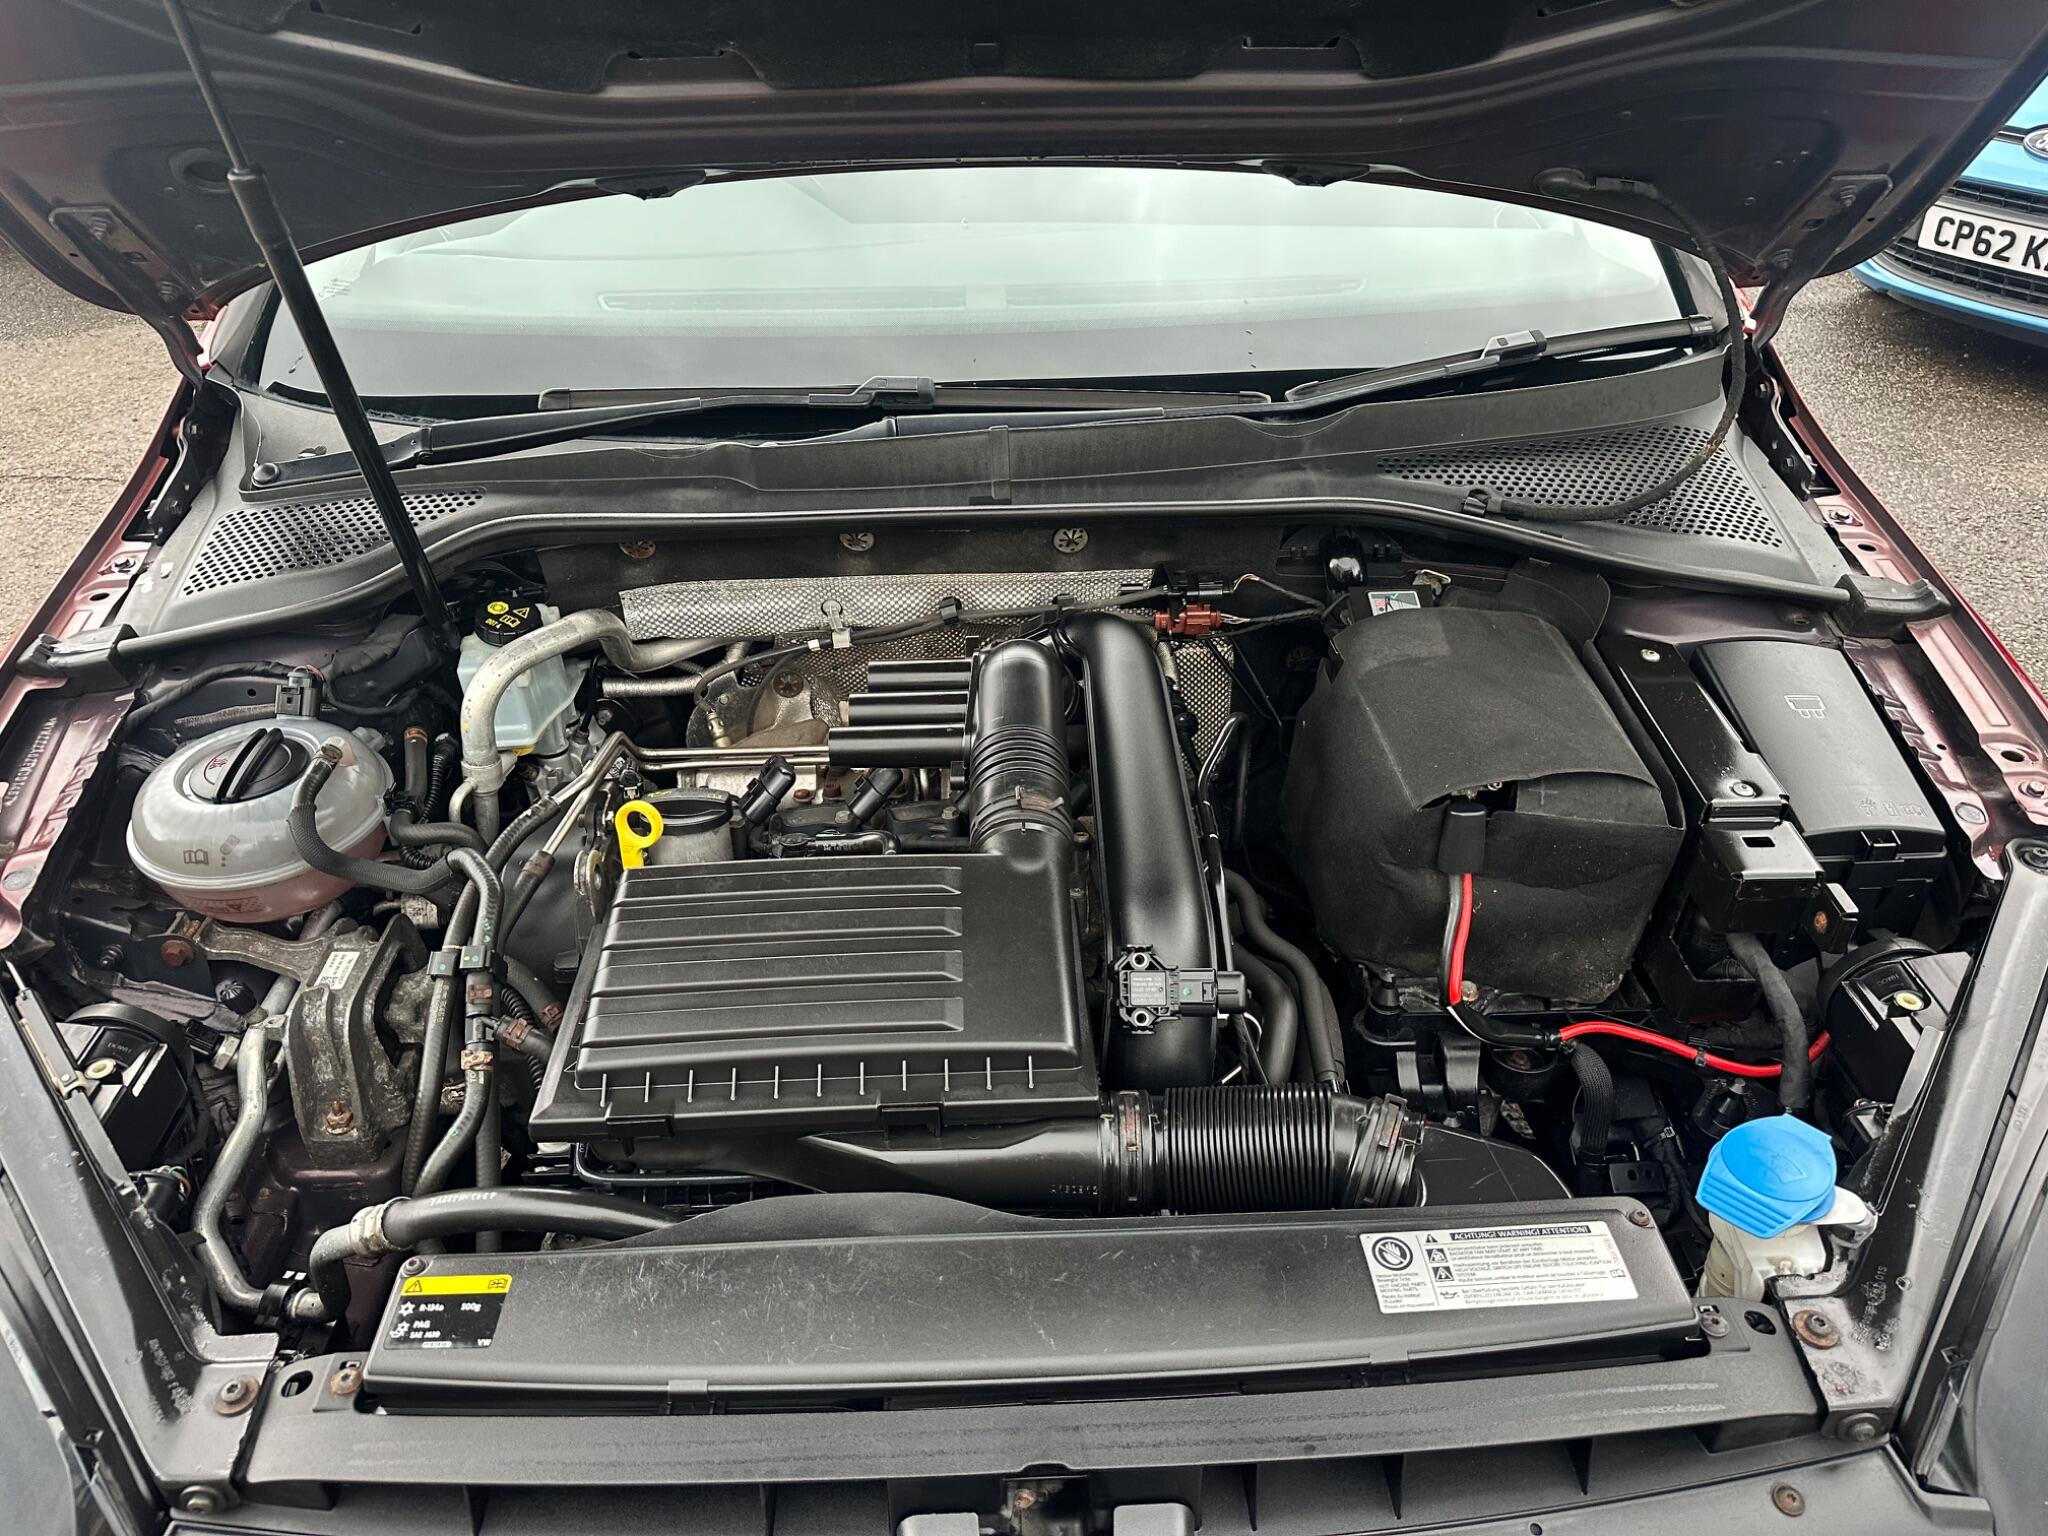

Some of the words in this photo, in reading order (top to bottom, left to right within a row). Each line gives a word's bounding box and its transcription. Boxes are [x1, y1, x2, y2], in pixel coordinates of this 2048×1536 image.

[1934, 215, 2017, 263] CP62
[2021, 235, 2048, 271] K
[1454, 1230, 1497, 1240] ACHTUNG!
[1497, 1228, 1540, 1238] WARNING!
[1541, 1225, 1588, 1235] ATTENTION!
